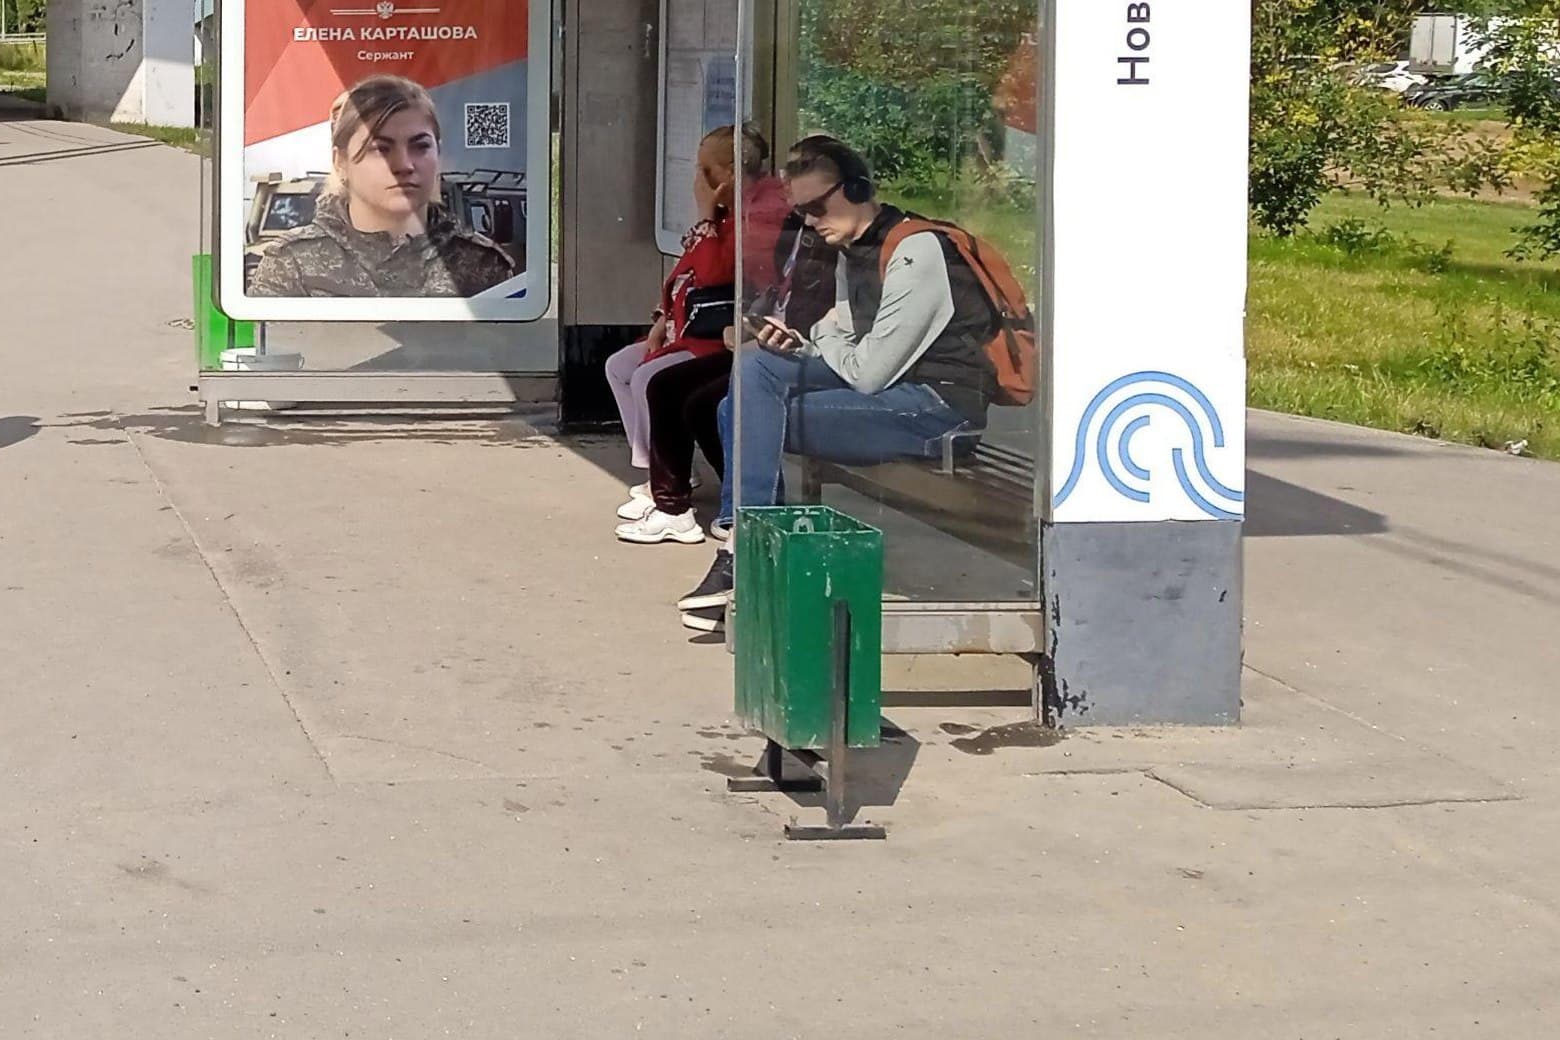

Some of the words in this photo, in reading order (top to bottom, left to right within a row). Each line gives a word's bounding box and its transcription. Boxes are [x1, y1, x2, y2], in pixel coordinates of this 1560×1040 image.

[293, 26, 356, 41] ЕЛЕНА
[360, 26, 478, 41] КАРТАШОВА
[357, 50, 415, 63] Сержант
